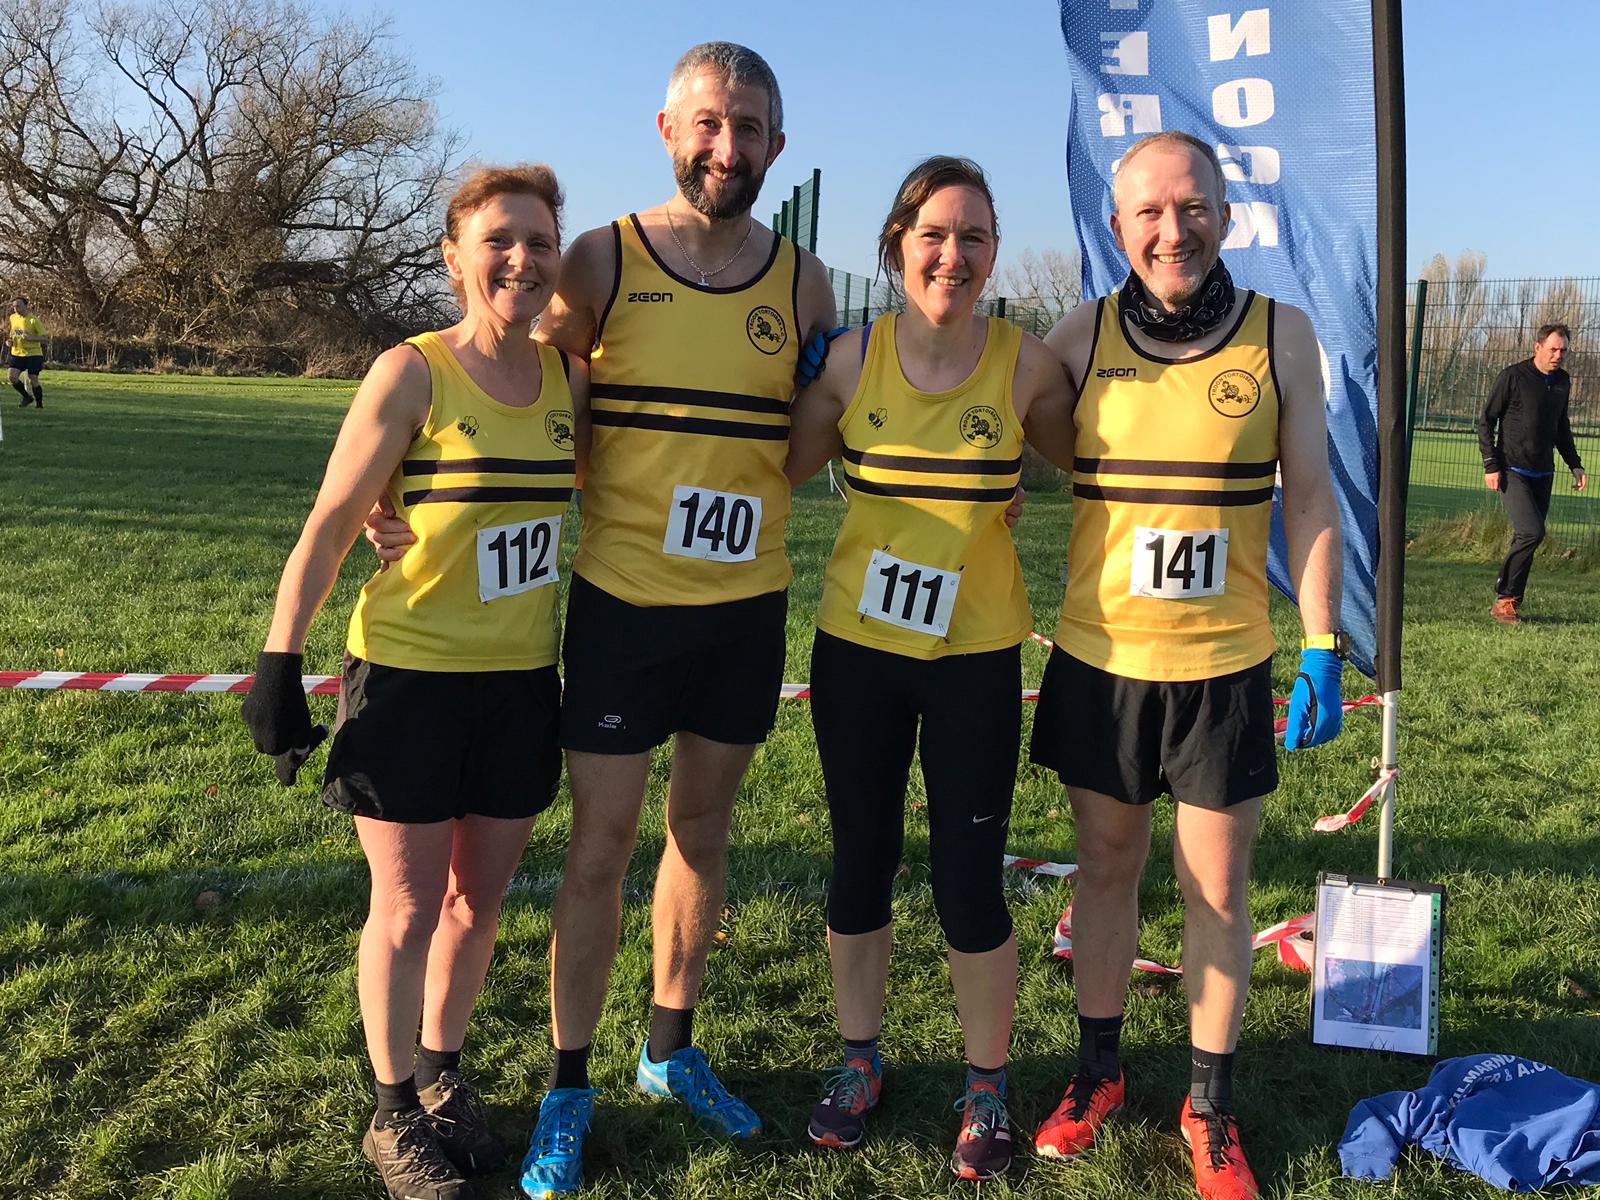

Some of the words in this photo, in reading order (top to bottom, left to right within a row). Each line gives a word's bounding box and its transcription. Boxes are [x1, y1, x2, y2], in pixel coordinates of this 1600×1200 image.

[628, 292, 673, 302] ZEON
[1096, 367, 1137, 378] ZEON
[680, 492, 754, 555] 140
[488, 522, 551, 589] 112
[1146, 534, 1216, 590] 141
[880, 563, 944, 625] 111
